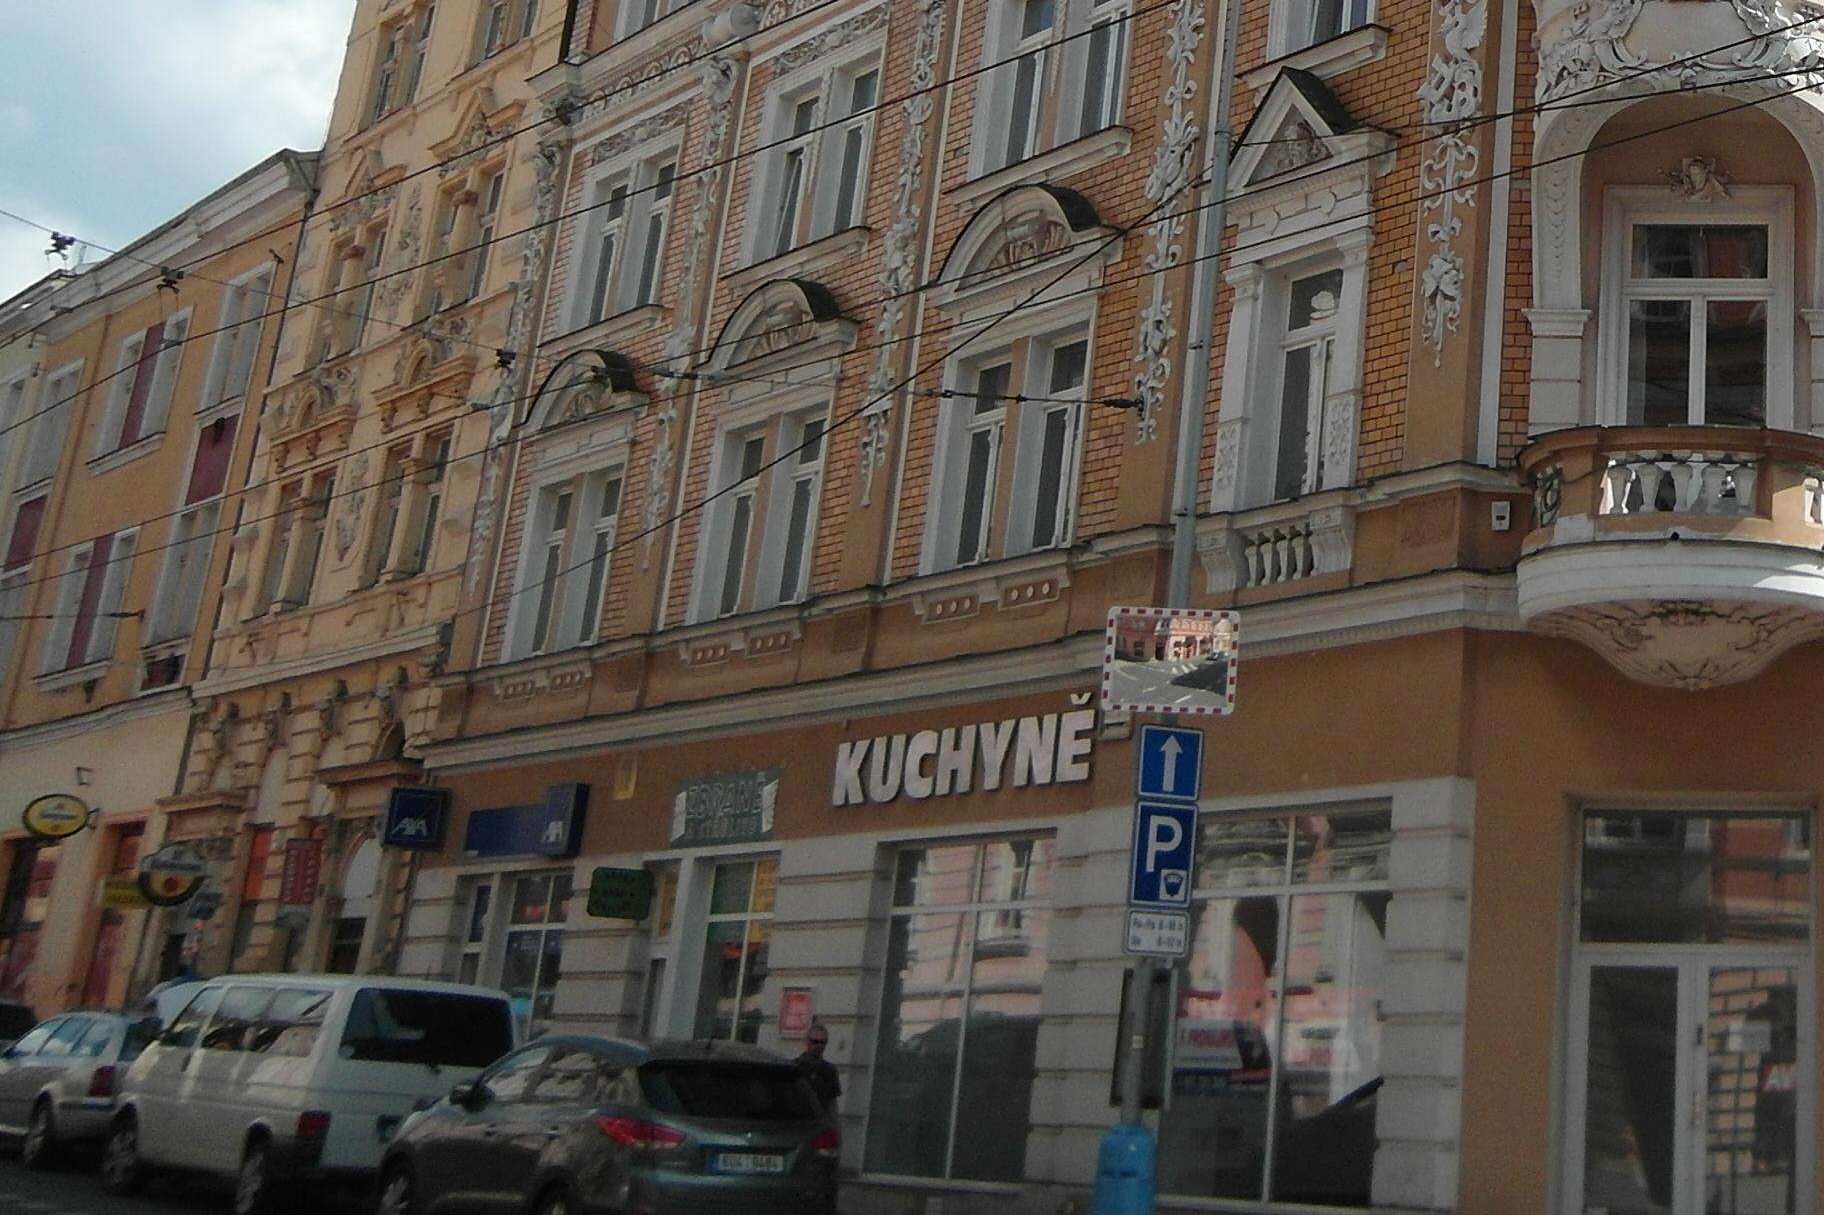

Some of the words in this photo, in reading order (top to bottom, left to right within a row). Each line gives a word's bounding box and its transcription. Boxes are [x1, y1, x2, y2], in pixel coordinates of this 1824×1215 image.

[832, 692, 1096, 806] KUCHYNĚ
[391, 816, 428, 837] AXA
[1146, 814, 1183, 873] P
